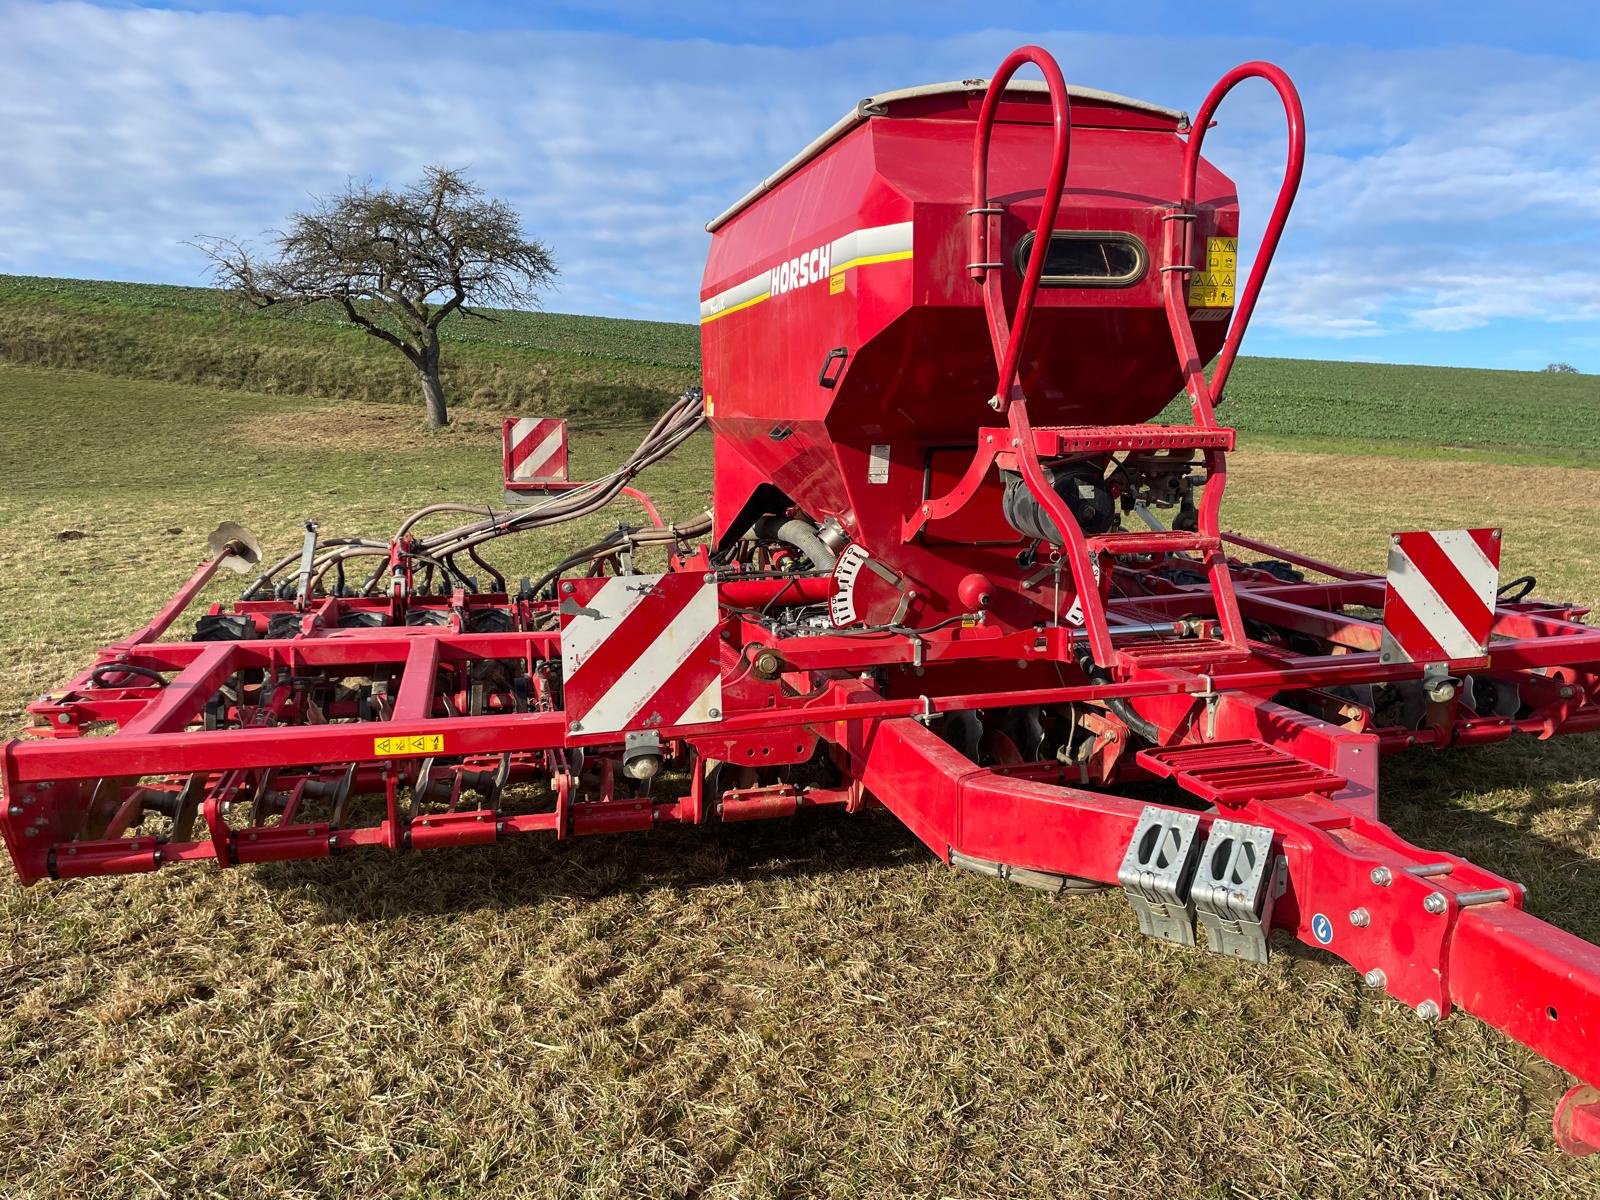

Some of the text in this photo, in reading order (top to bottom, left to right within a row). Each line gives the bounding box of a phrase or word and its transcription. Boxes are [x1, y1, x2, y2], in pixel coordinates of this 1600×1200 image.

[771, 242, 831, 297] HORSCH
[847, 547, 854, 555] 0
[837, 566, 843, 574] 2
[832, 606, 838, 614] 6
